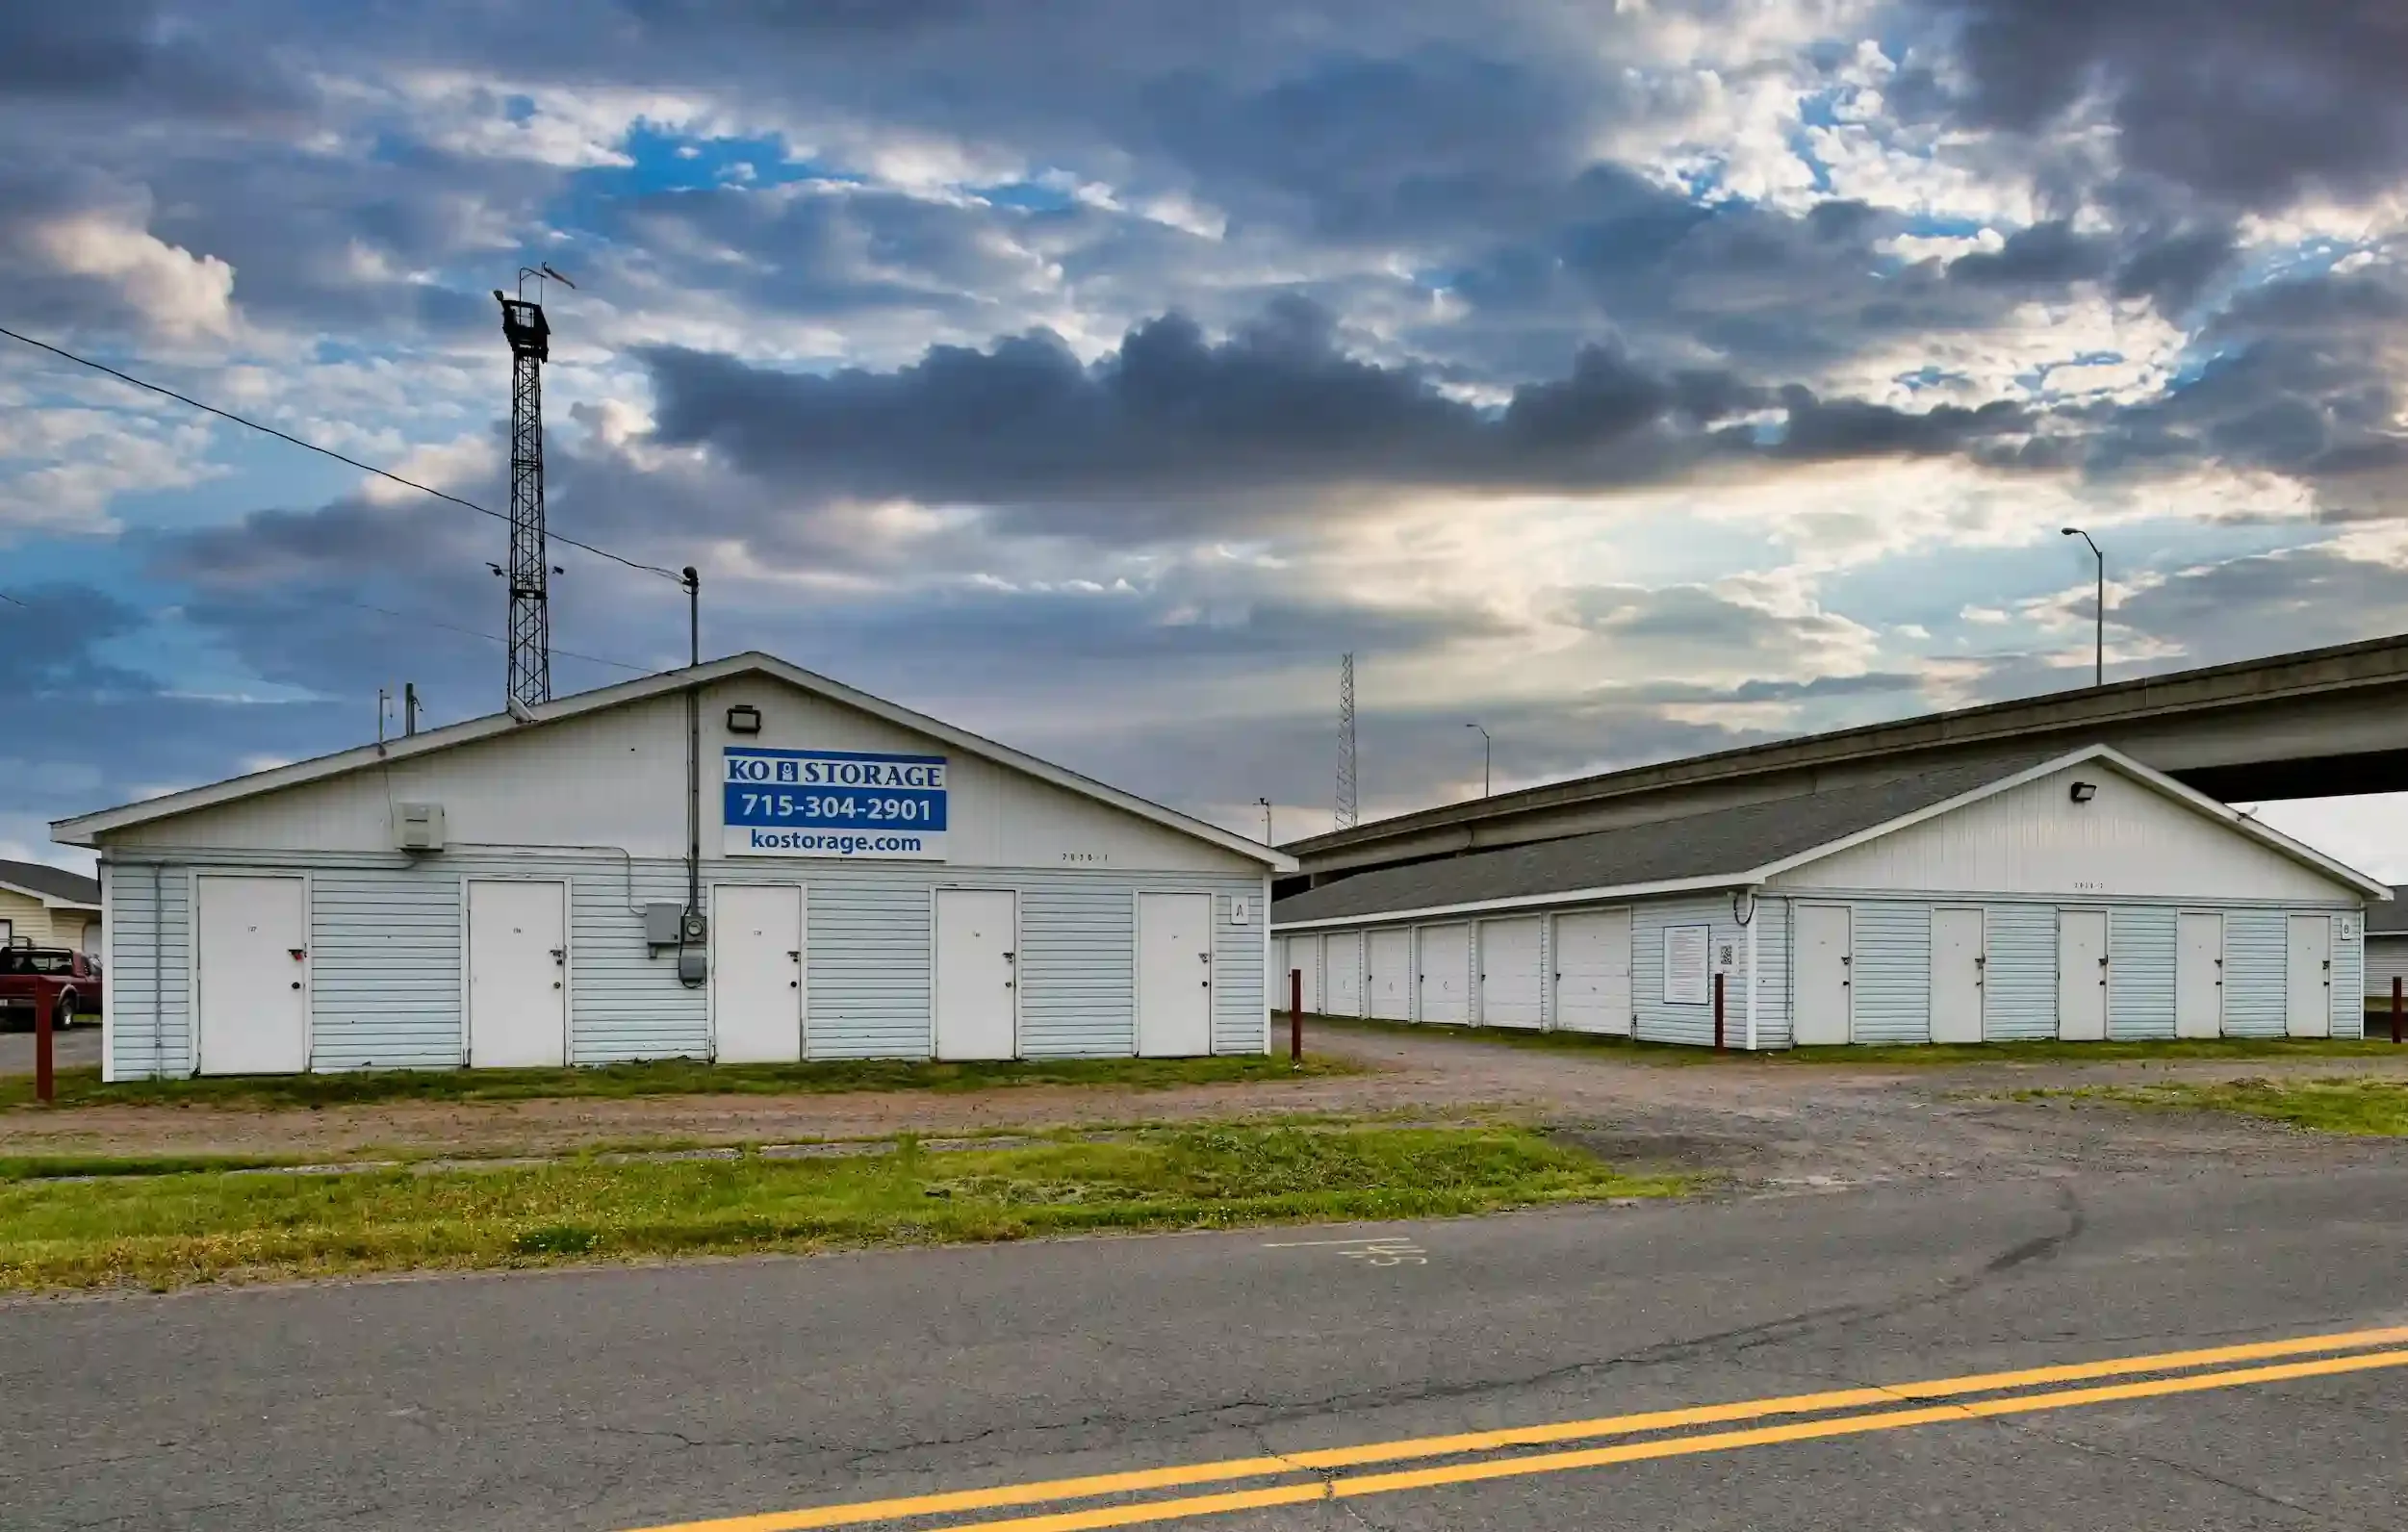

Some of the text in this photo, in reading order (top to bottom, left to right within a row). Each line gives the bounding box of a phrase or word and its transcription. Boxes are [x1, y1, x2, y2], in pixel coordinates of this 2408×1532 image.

[727, 759, 942, 787] KO STORAGE
[741, 793, 931, 821] 715-304-2901
[751, 829, 922, 855] kostorage.com
[1236, 904, 1244, 917] A
